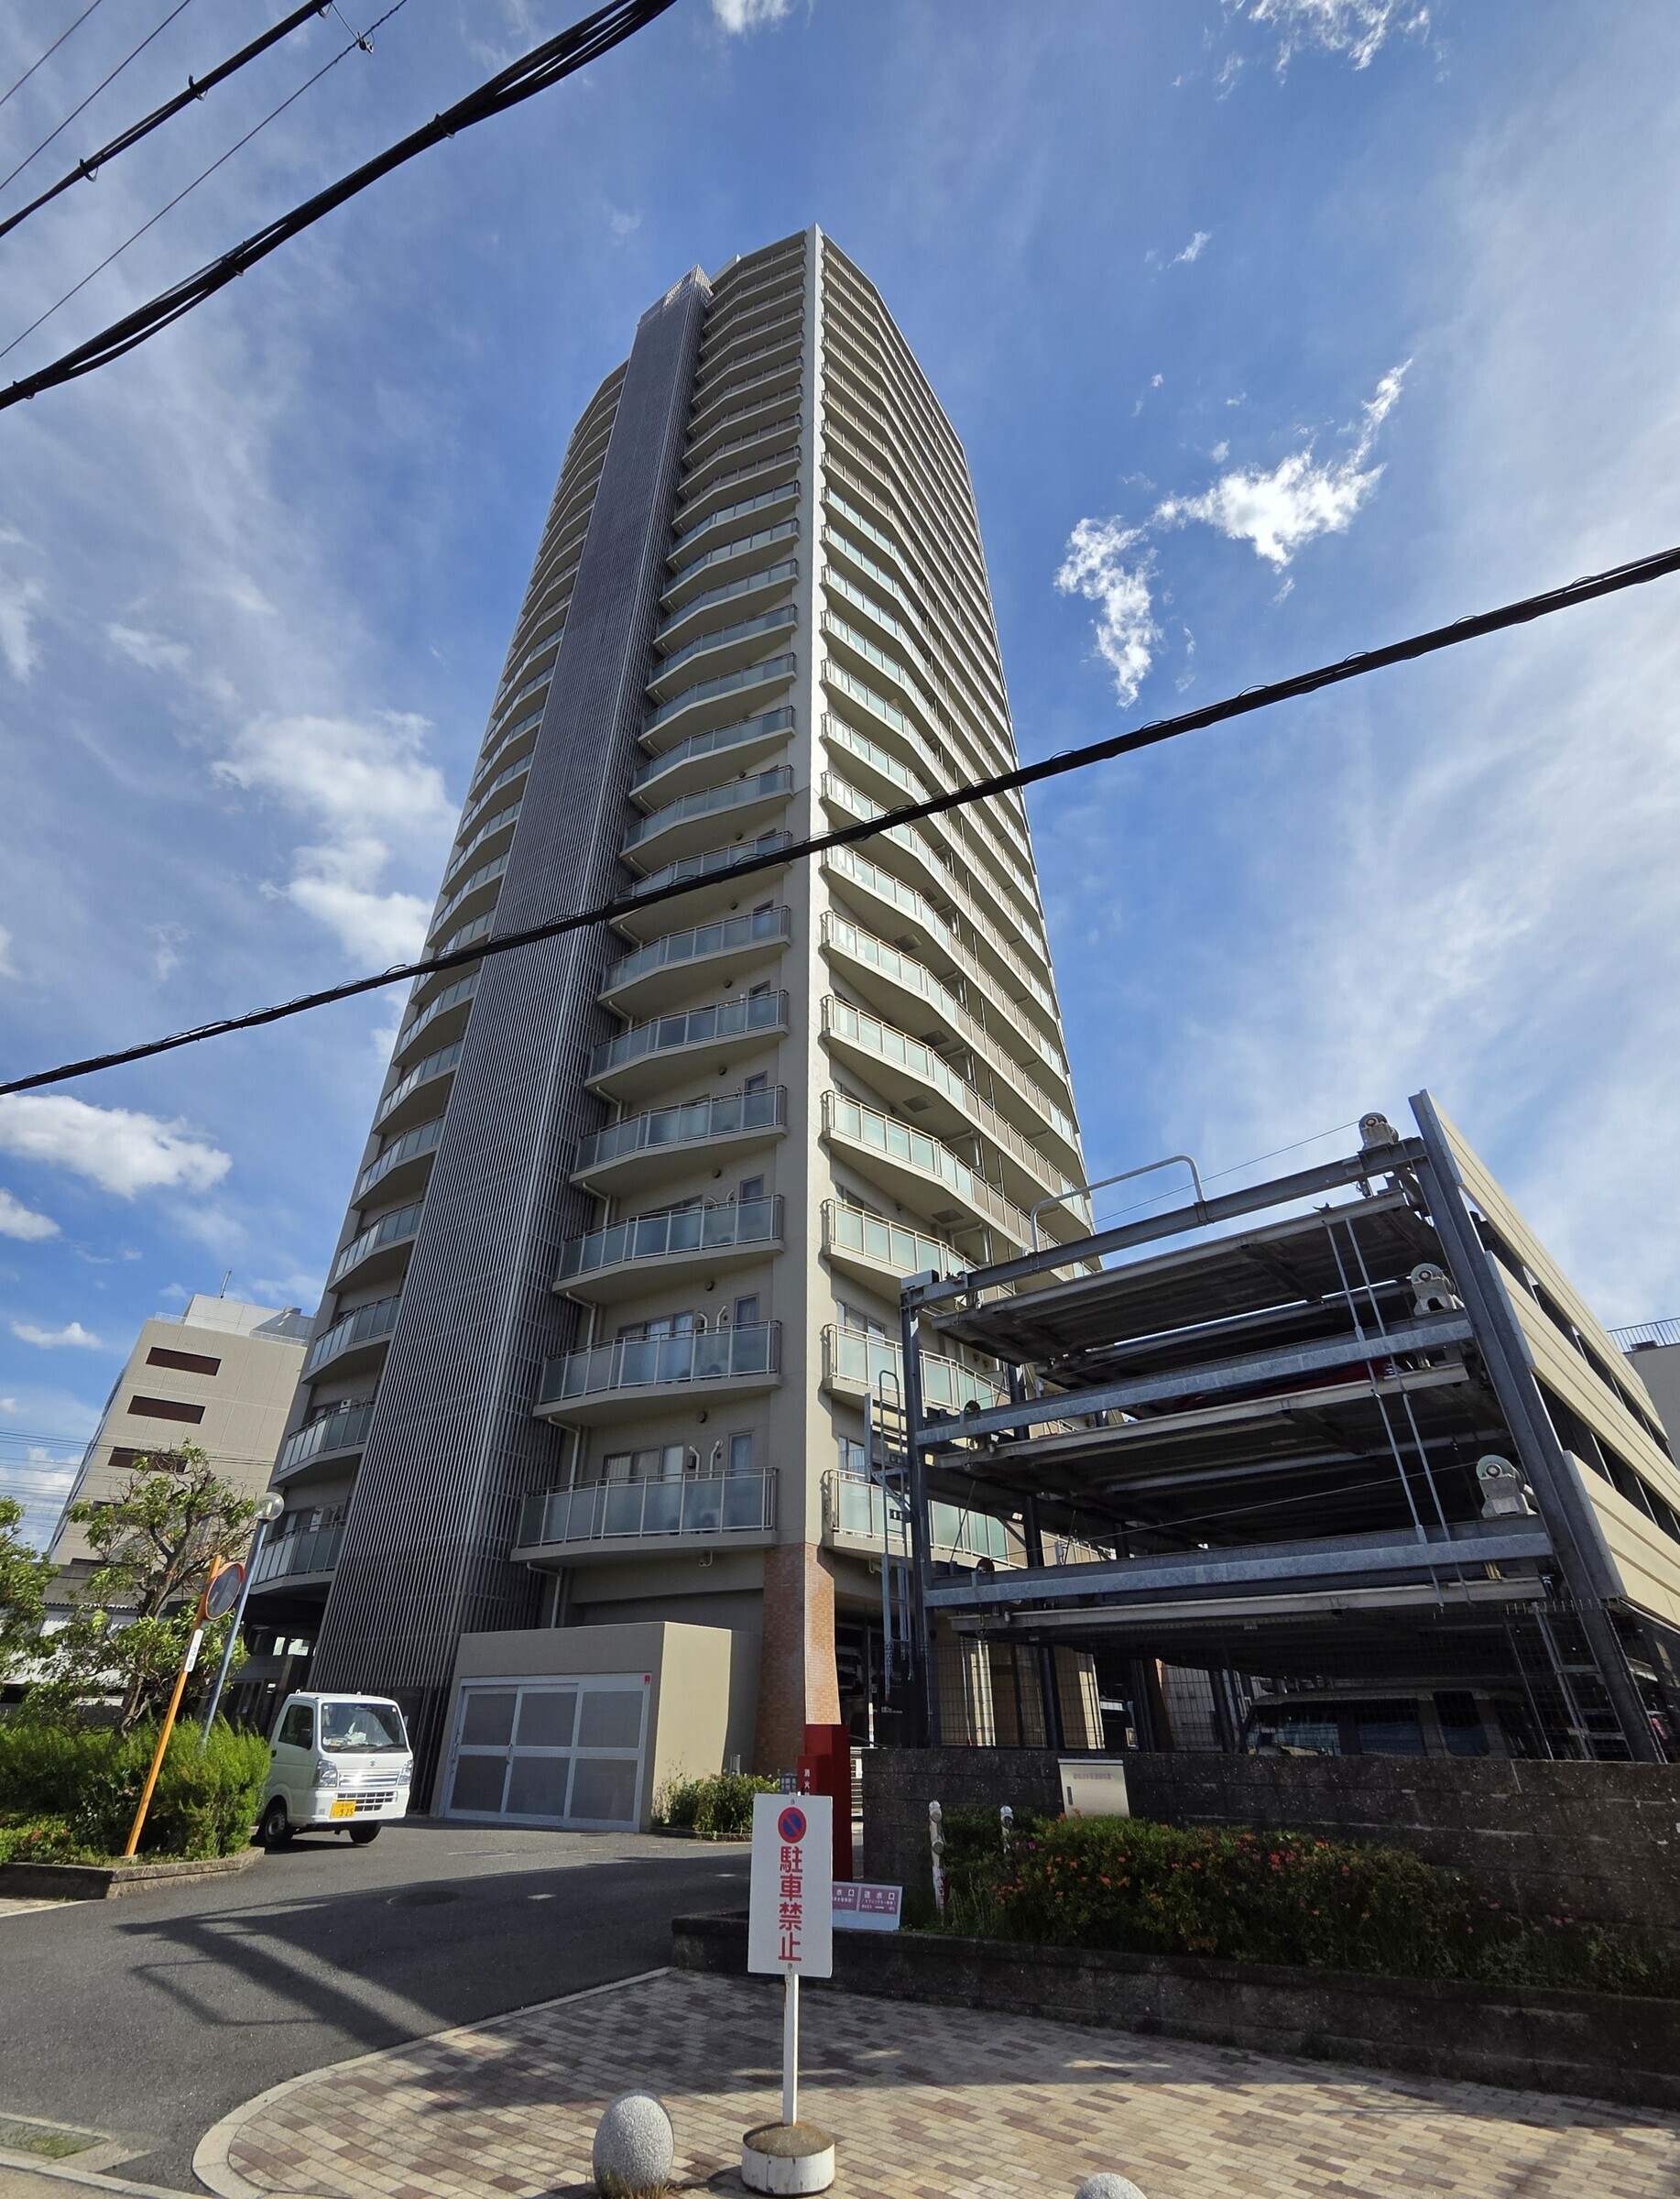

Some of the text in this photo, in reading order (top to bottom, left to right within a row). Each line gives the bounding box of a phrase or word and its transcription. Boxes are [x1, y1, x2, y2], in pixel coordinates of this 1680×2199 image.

[779, 1846, 802, 1961] 駐車禁止
[835, 1888, 855, 1898] 水口
